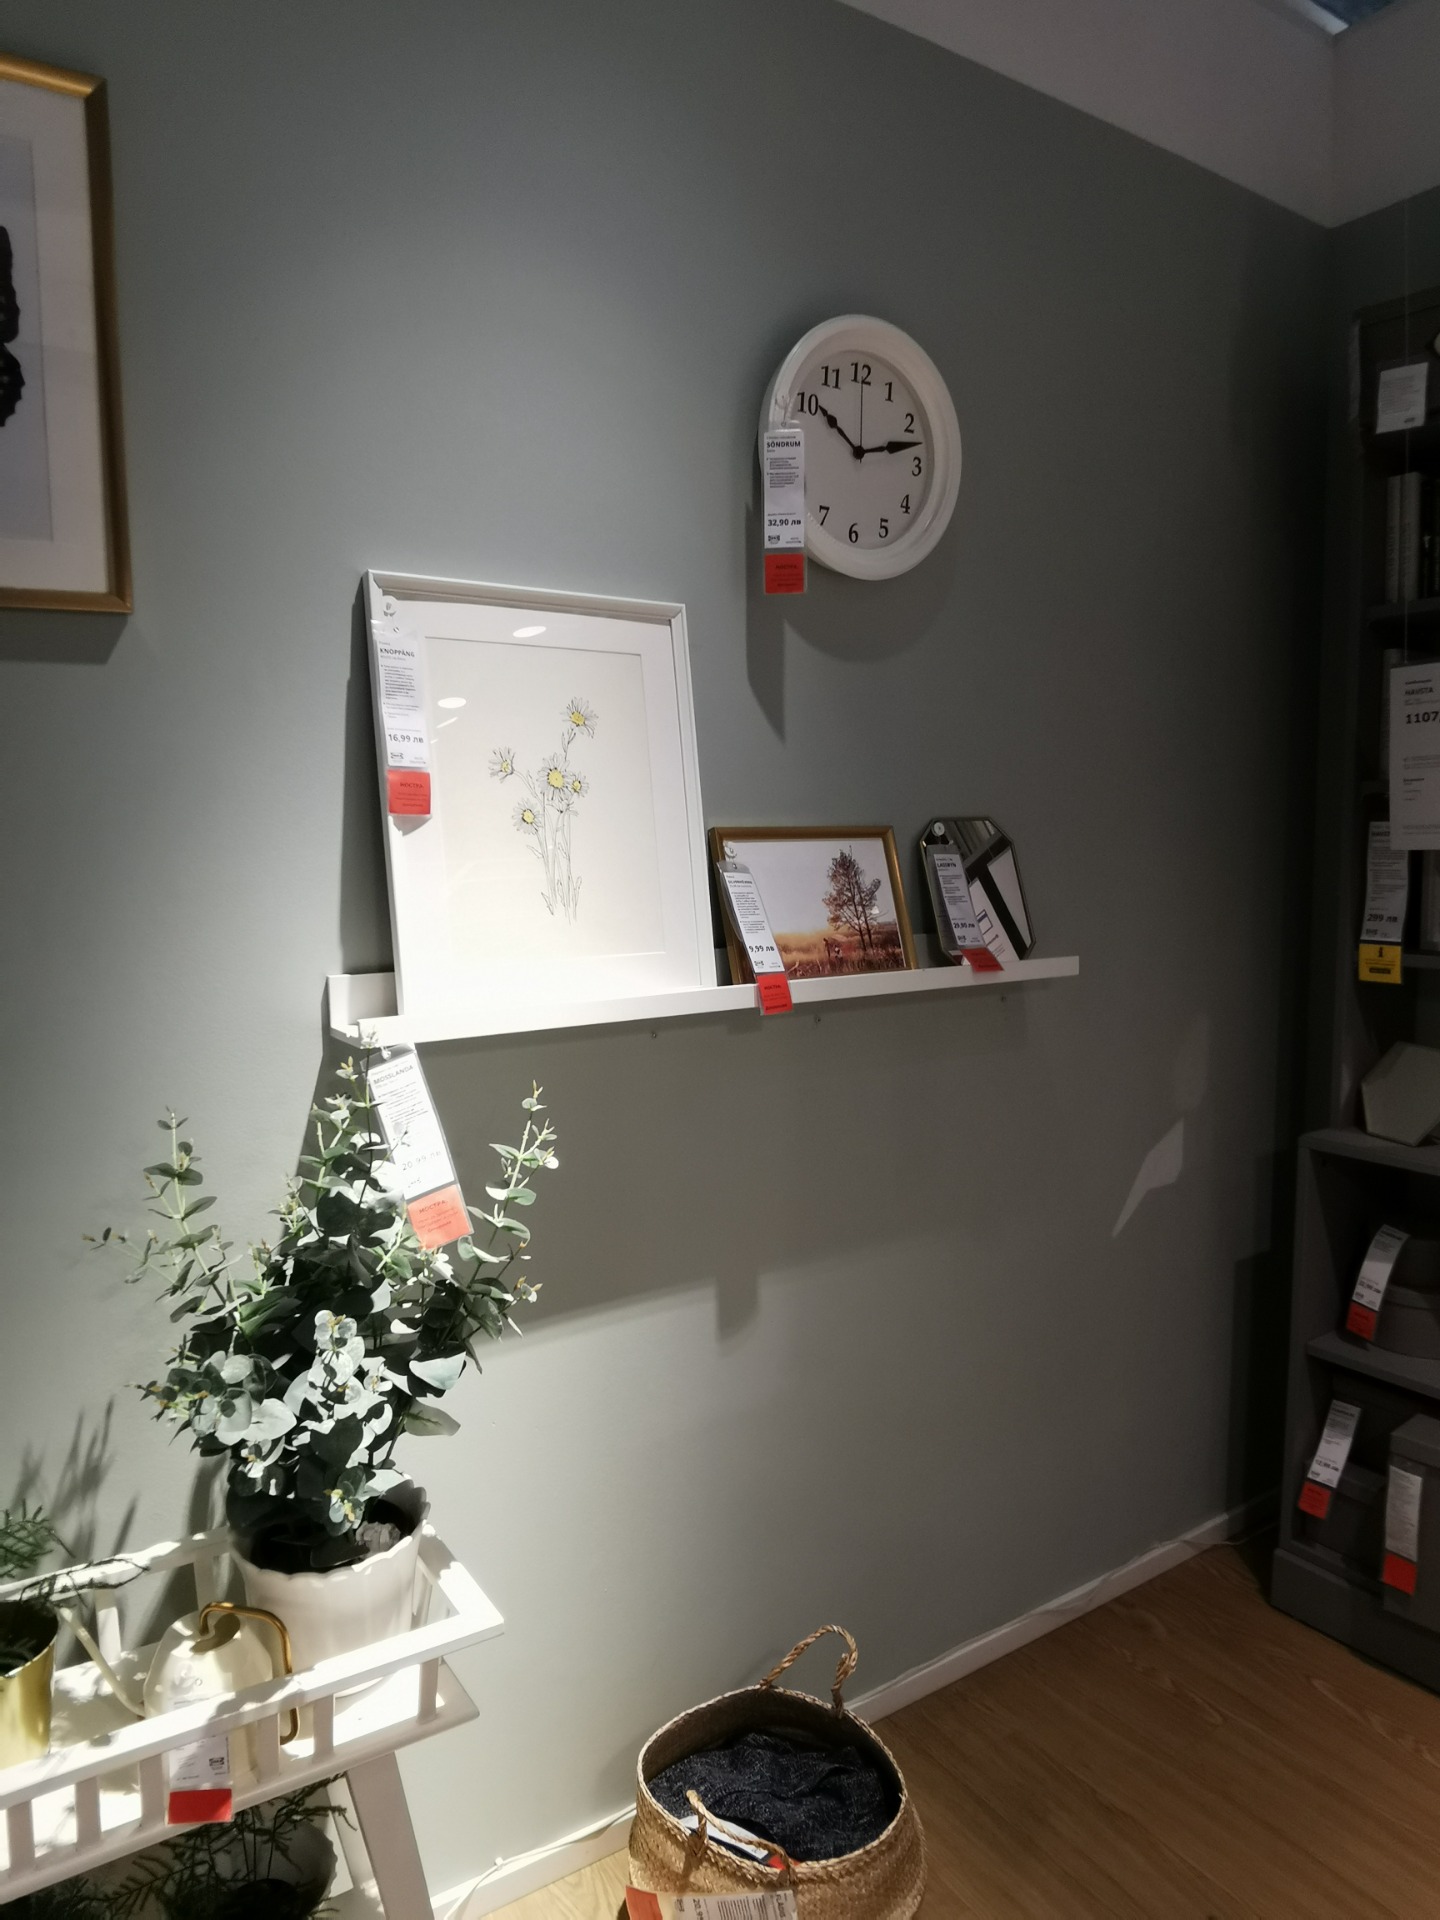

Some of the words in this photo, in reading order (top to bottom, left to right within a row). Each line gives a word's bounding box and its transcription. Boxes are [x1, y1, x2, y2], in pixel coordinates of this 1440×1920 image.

[821, 365, 841, 389] 11
[850, 362, 872, 386] 12
[885, 381, 894, 402] 1
[797, 391, 819, 416] 10
[904, 413, 915, 433] 2
[766, 440, 801, 448] SÖNDRUM
[911, 456, 922, 476] 3
[900, 494, 911, 514] 4
[768, 518, 789, 527] 32,90
[819, 505, 830, 526] 7
[848, 523, 858, 543] 6
[878, 518, 889, 538] 5
[1406, 711, 1440, 724] 1107
[388, 734, 411, 743] 16,99
